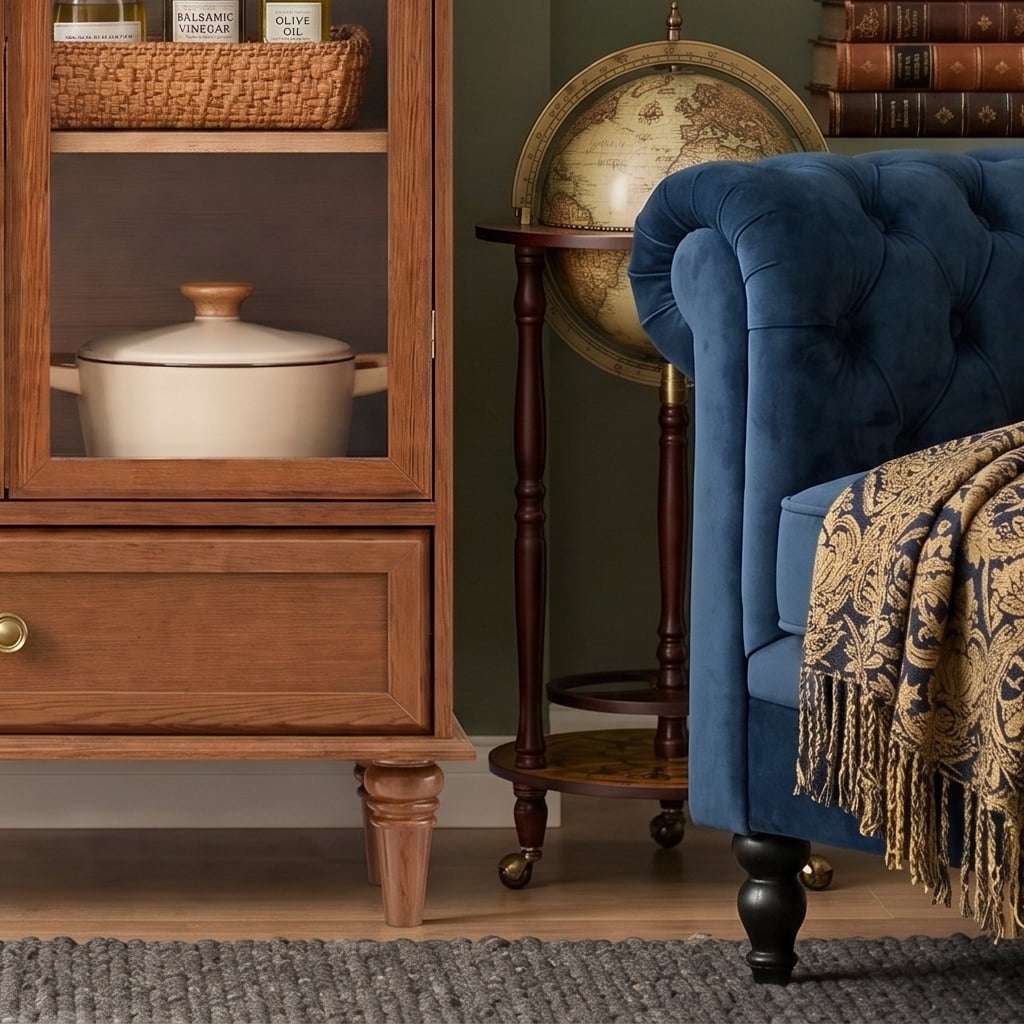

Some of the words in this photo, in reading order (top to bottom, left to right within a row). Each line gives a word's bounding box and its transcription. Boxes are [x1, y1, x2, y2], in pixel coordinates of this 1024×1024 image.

[177, 12, 234, 22] BALSAMIC
[275, 16, 310, 25] OLIVE
[178, 24, 230, 33] VINEGAR
[283, 27, 303, 36] OIL
